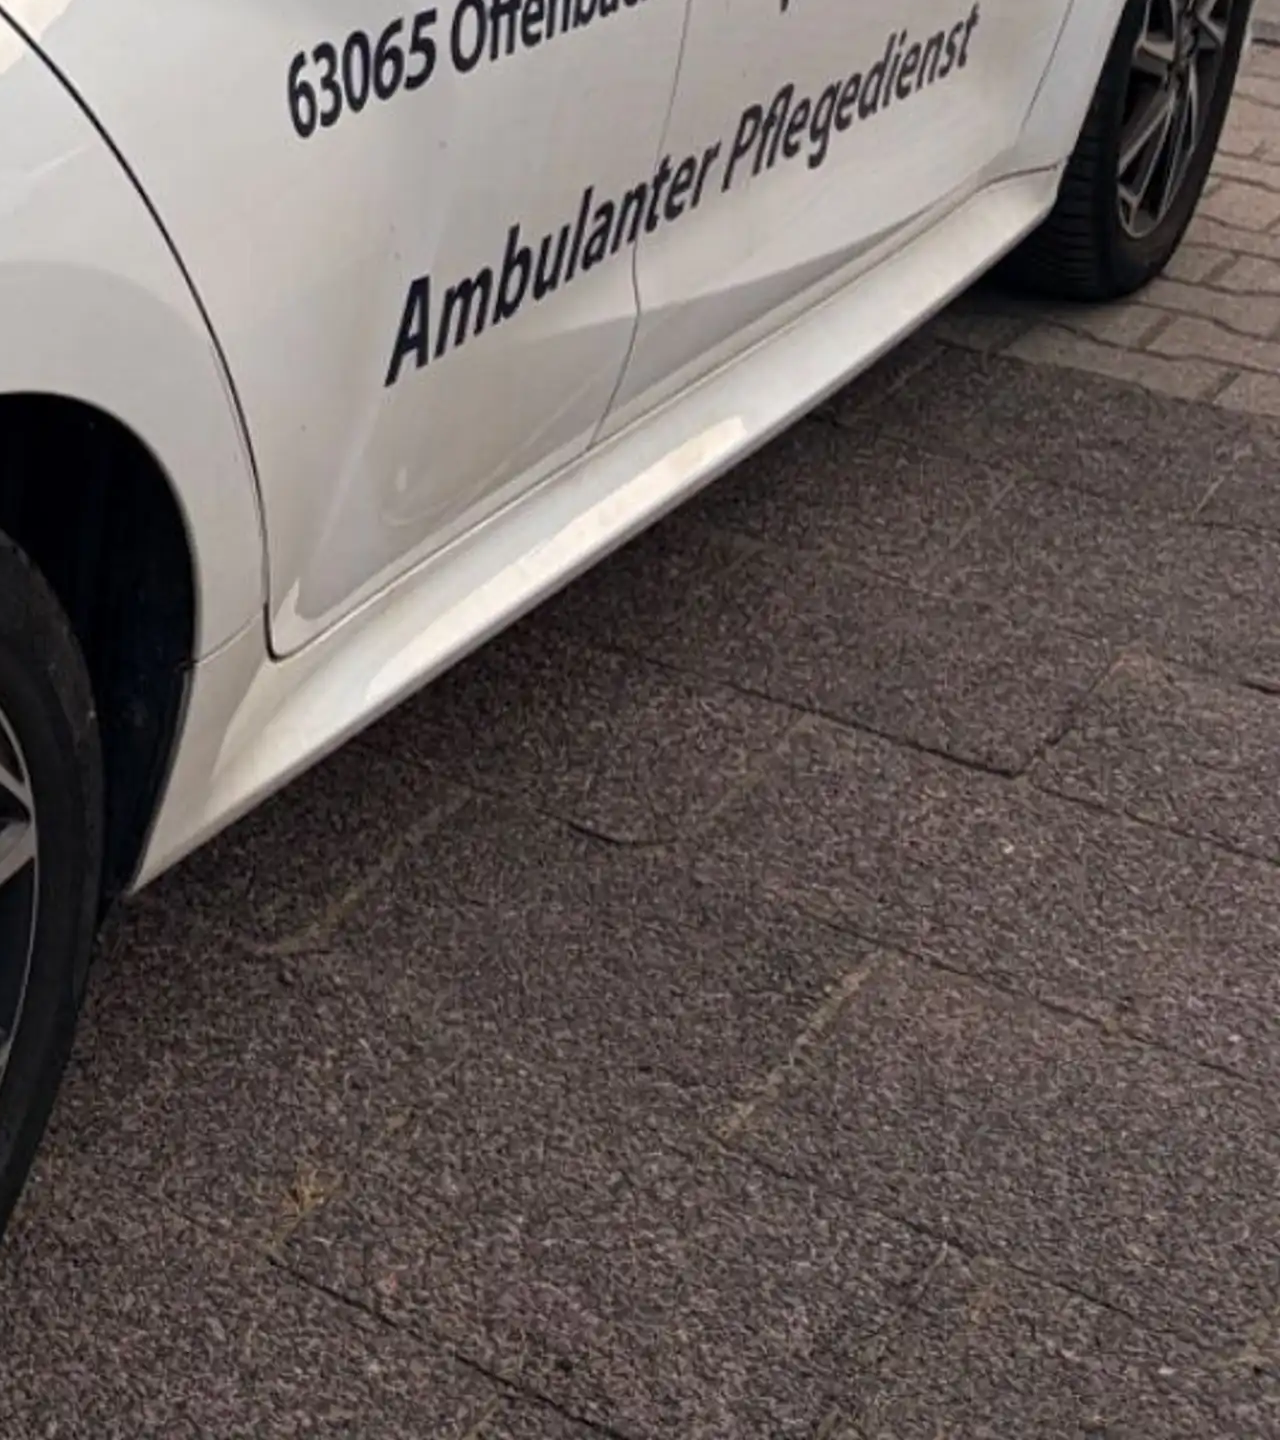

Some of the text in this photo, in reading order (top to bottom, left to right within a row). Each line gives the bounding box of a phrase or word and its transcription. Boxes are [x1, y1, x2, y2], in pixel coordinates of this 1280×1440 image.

[287, 7, 438, 139] 63065
[383, 1, 980, 389] Ambulanter Pflegedienst
